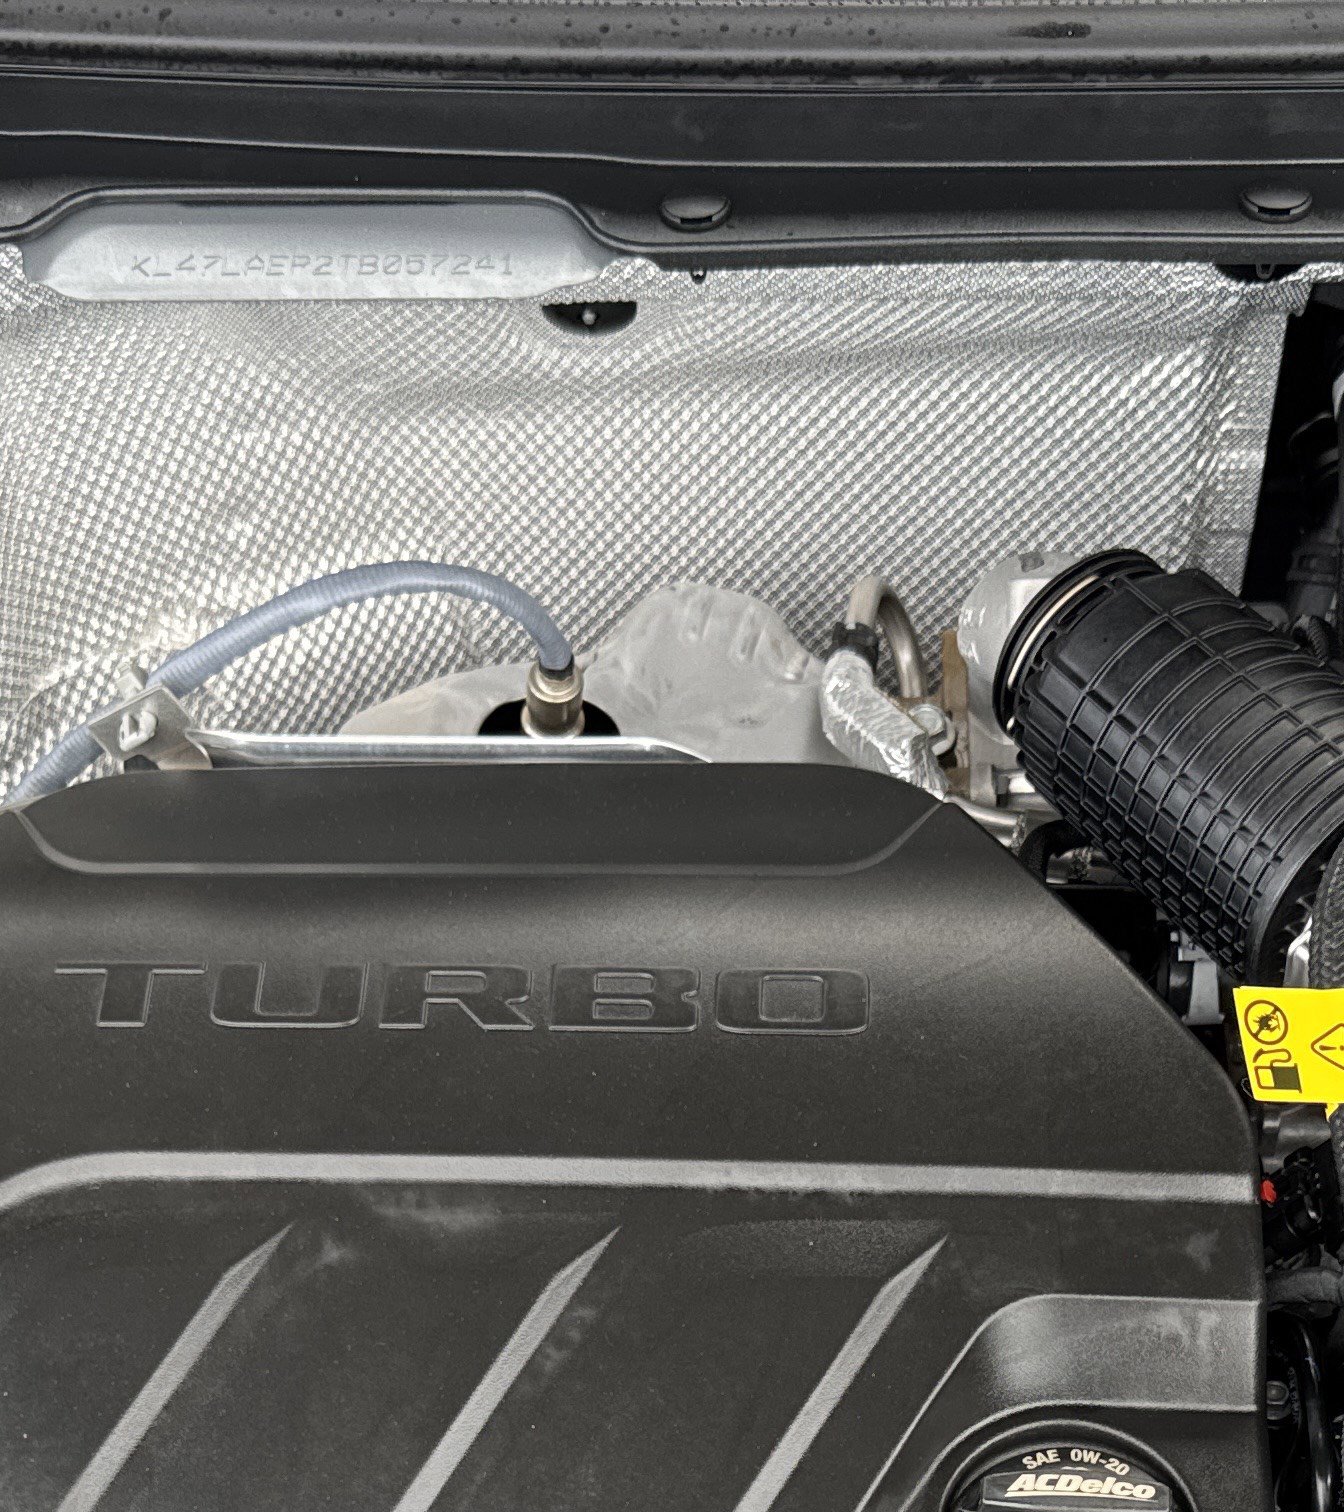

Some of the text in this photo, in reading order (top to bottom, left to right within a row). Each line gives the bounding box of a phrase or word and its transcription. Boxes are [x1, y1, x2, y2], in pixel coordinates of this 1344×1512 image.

[54, 961, 871, 1035] TURBO
[1021, 1448, 1131, 1476] SAE 0W-20
[1006, 1473, 1156, 1499] ACDelco
